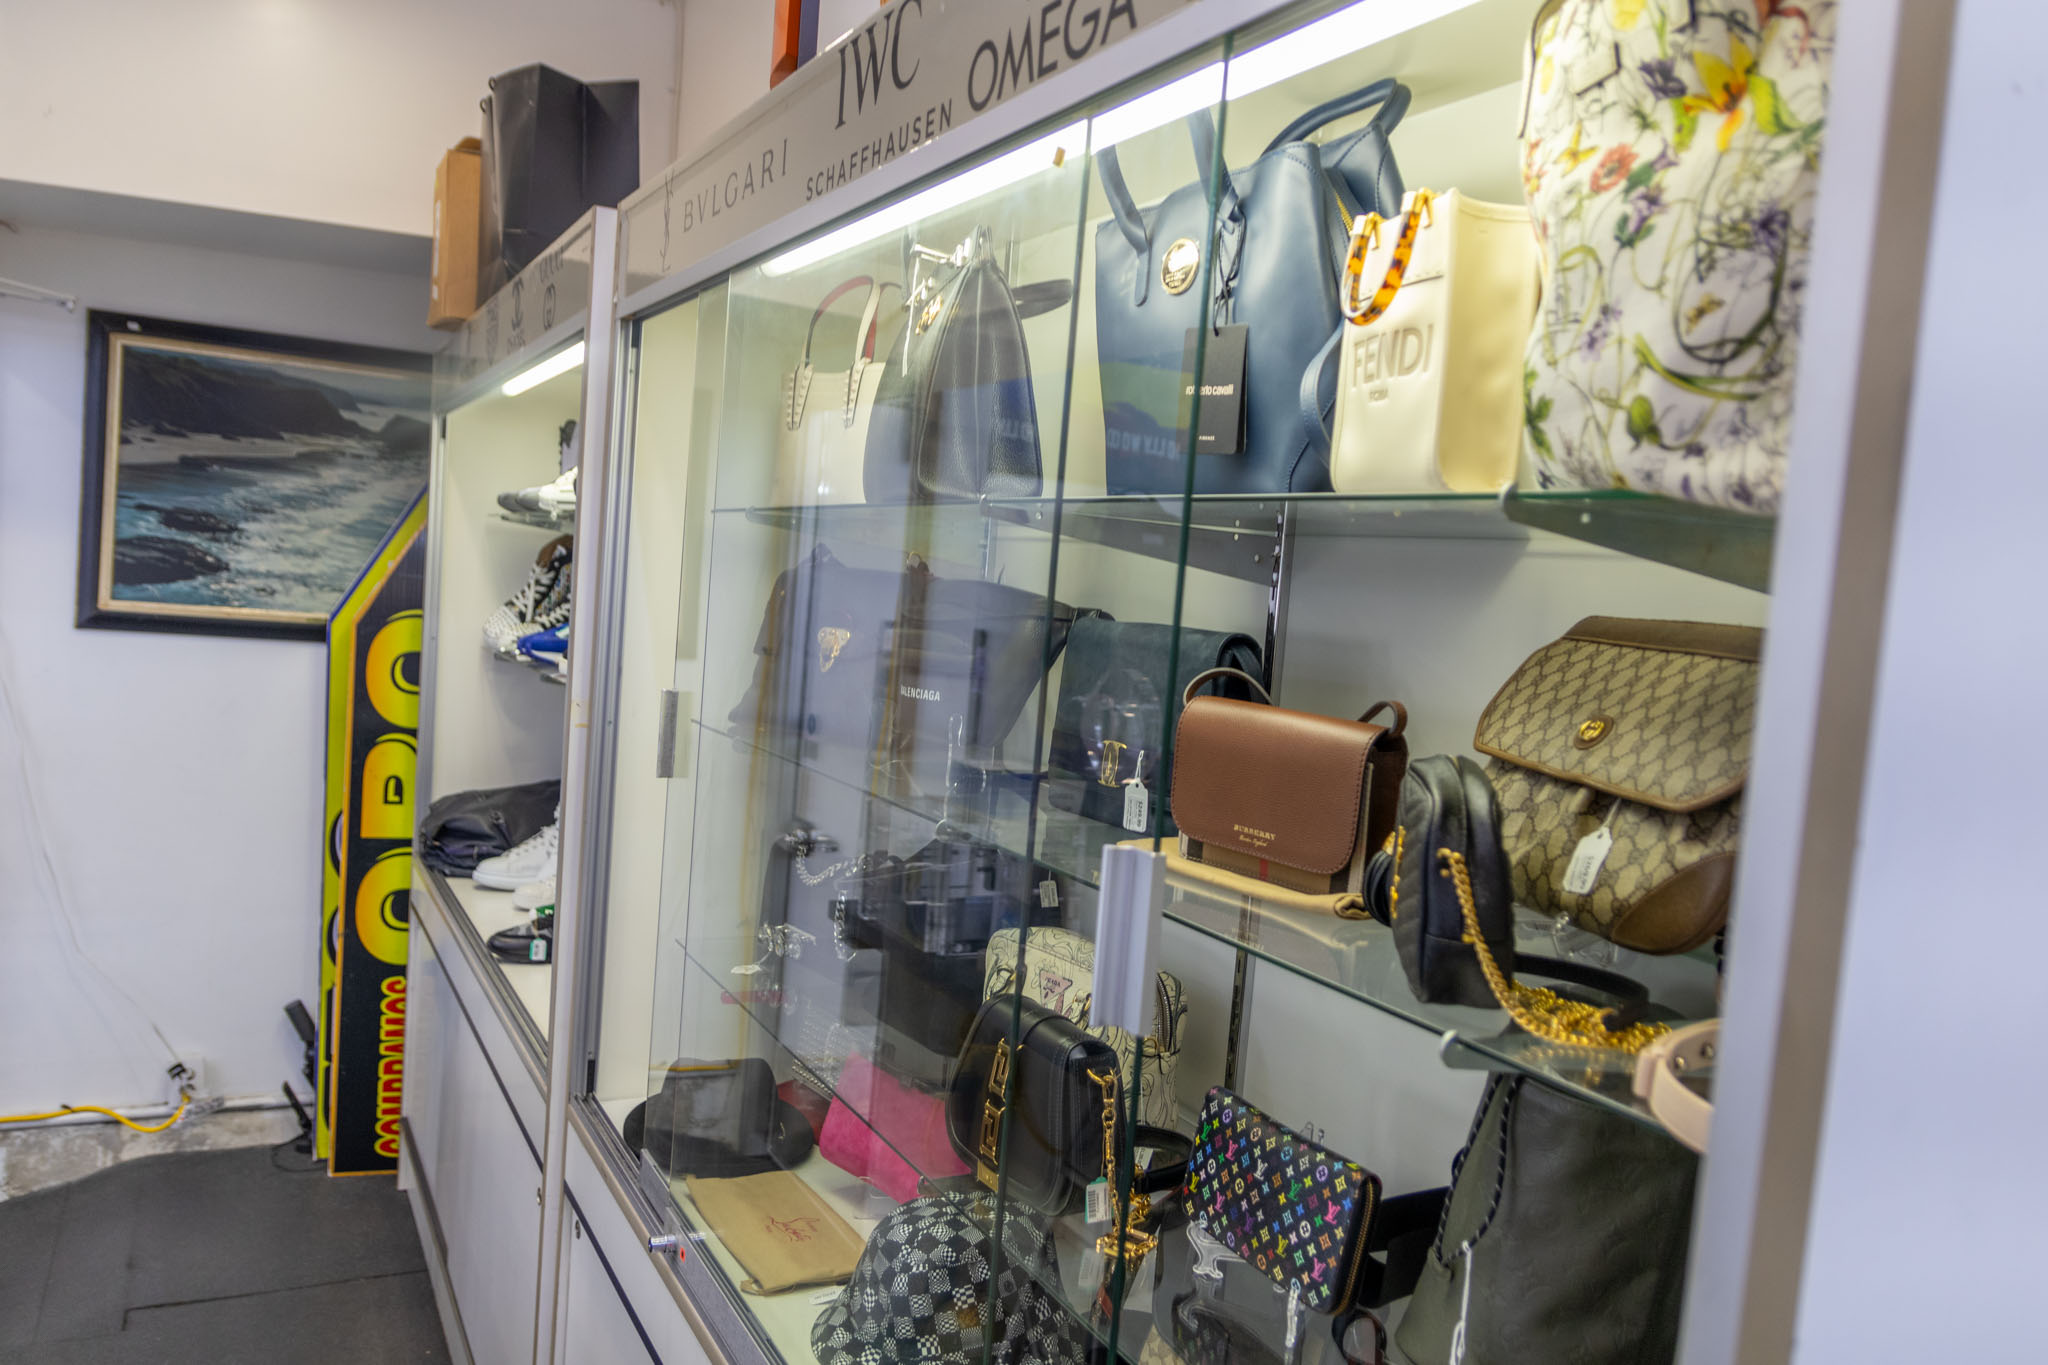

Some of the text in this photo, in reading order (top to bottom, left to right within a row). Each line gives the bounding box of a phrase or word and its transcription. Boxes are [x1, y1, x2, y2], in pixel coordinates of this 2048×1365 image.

[835, 0, 922, 130] IWC
[968, 0, 1137, 112] OMEGA
[684, 138, 788, 233] BVLGARI
[806, 98, 953, 201] SCHAFFHAUSEN
[1185, 384, 1212, 396] roerto
[1352, 322, 1434, 388] FENDI
[1233, 823, 1276, 840] BURBERRY
